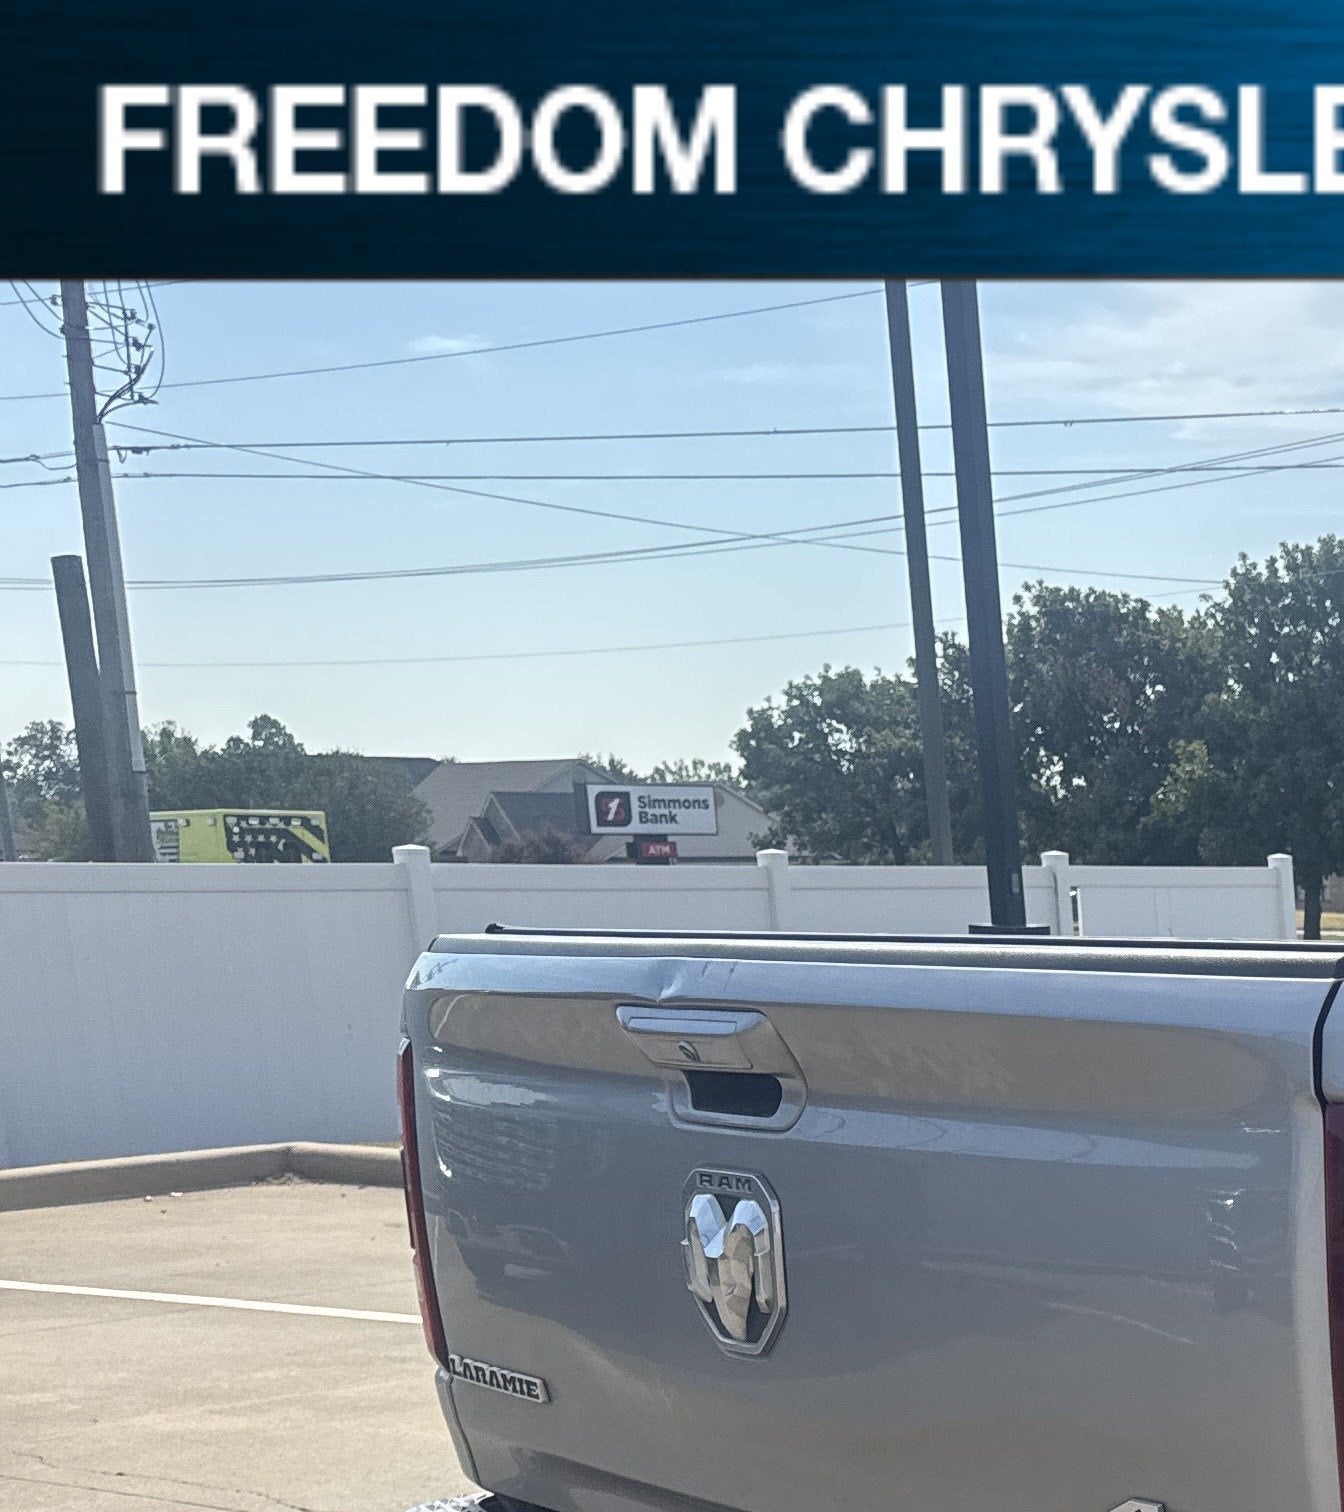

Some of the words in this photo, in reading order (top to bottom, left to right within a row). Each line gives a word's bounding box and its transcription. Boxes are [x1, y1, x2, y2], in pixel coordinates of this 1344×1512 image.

[637, 794, 710, 810] Simmons
[638, 810, 679, 825] Bank
[699, 1172, 752, 1194] RAM
[450, 1355, 543, 1402] LARAMIE
